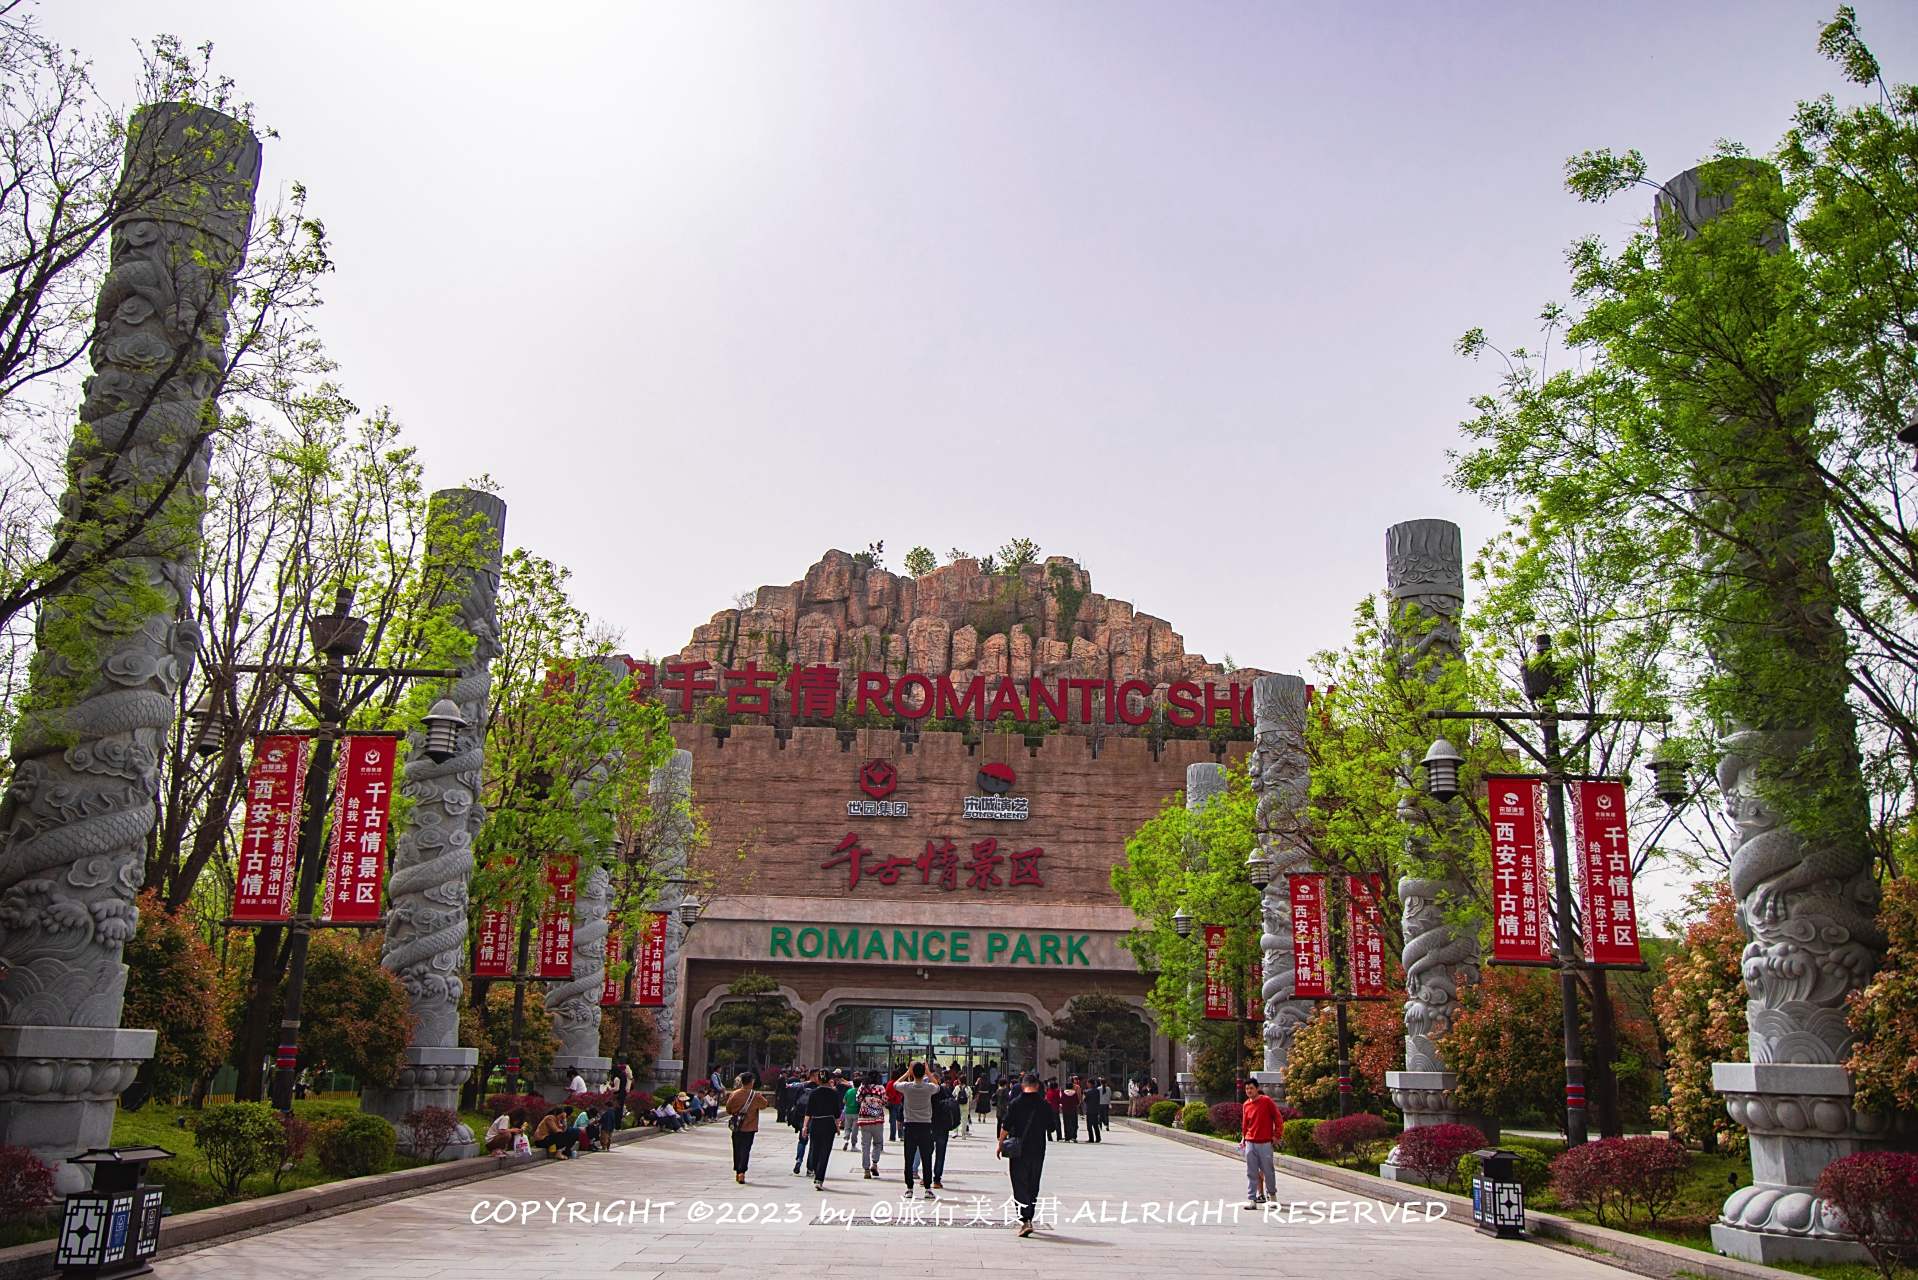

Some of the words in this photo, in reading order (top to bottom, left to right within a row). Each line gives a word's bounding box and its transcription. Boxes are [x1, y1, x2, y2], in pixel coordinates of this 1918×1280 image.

[855, 671, 1153, 727] ROMANTIC
[345, 797, 361, 843] 给我一天
[847, 800, 909, 816] 世园集团
[242, 780, 275, 896] 西安千古情
[267, 802, 290, 896] 一生必看的演出
[356, 781, 387, 904] 千古情景区
[821, 832, 1044, 891] 千古情景区
[1589, 841, 1604, 886] 给我一天
[338, 852, 354, 903] 还你千年
[1494, 822, 1520, 937] 西安千古情
[1520, 844, 1537, 938] 一生必看的演出
[1604, 826, 1634, 947] 千古情景区
[770, 927, 970, 962] ROMANCE
[987, 932, 1090, 966] PARK
[1594, 895, 1609, 946] 还你千年
[650, 935, 663, 997] 千古情景区
